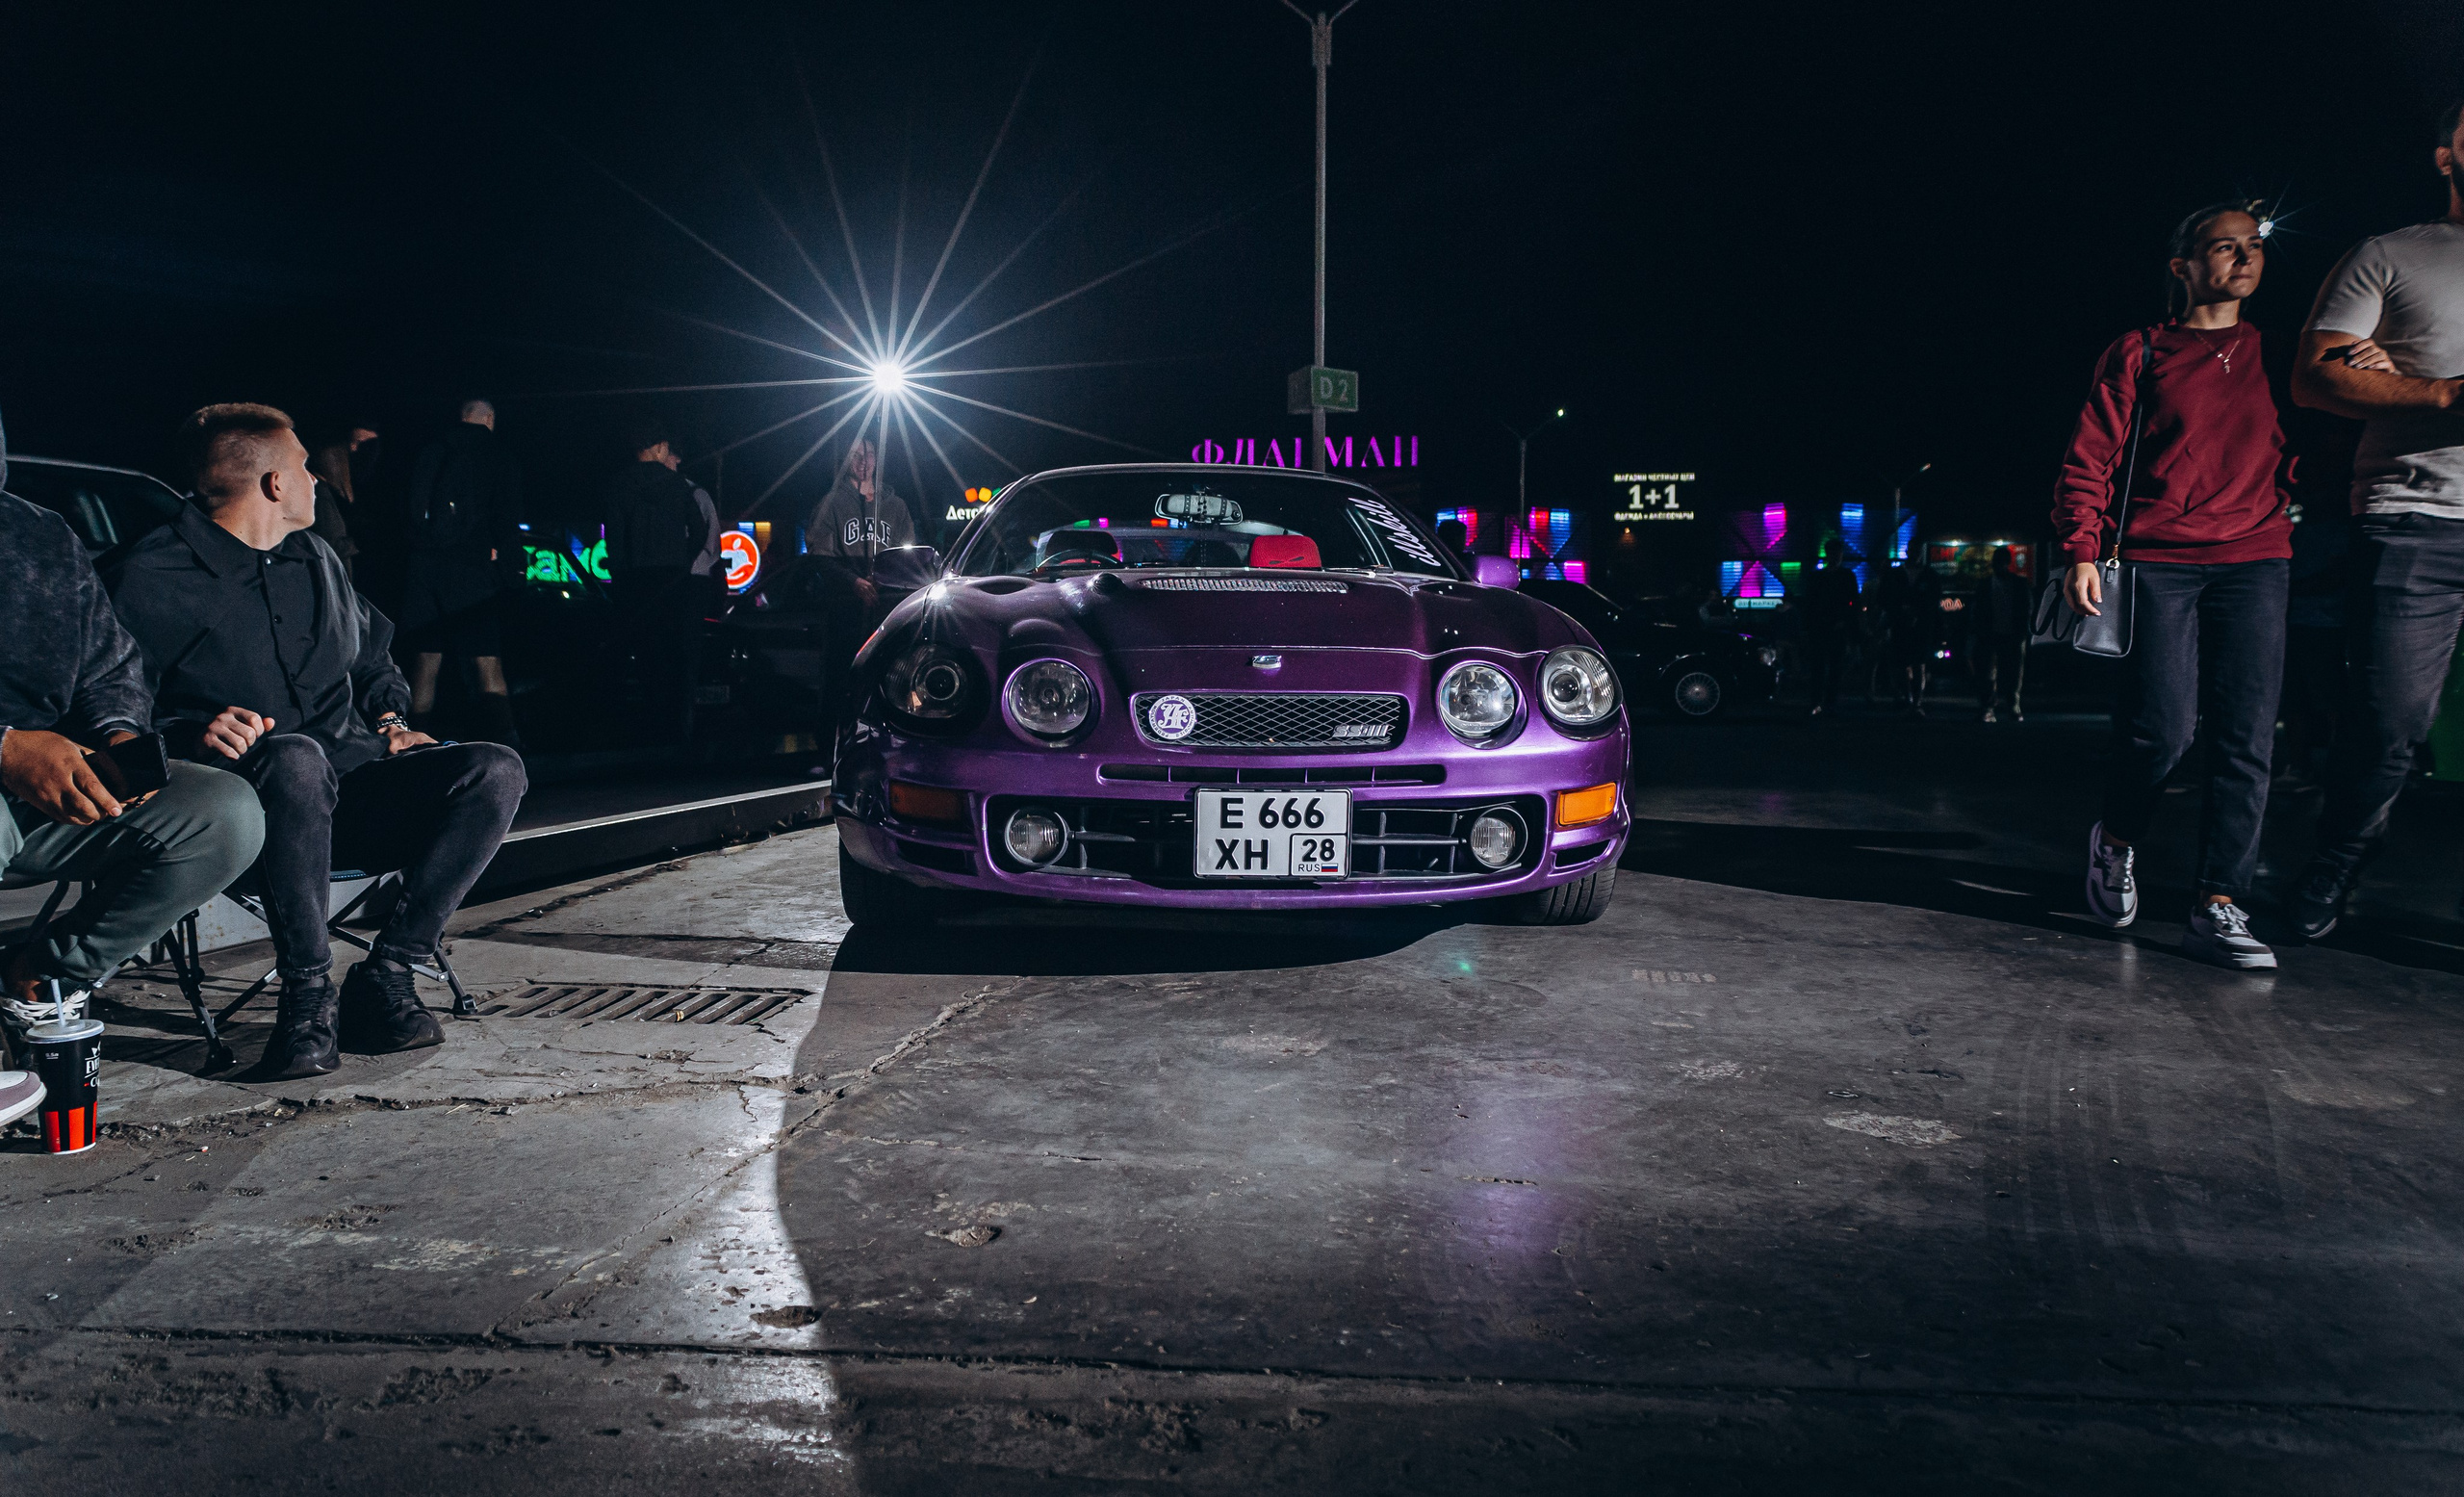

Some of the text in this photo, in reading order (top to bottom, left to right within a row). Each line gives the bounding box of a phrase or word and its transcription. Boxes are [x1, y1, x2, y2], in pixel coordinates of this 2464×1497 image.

[1629, 484, 1680, 509] 1+1
[945, 504, 980, 521] Детс
[1258, 797, 1326, 829] 666
[1301, 838, 1336, 863] 28
[1297, 864, 1321, 872] RUS
